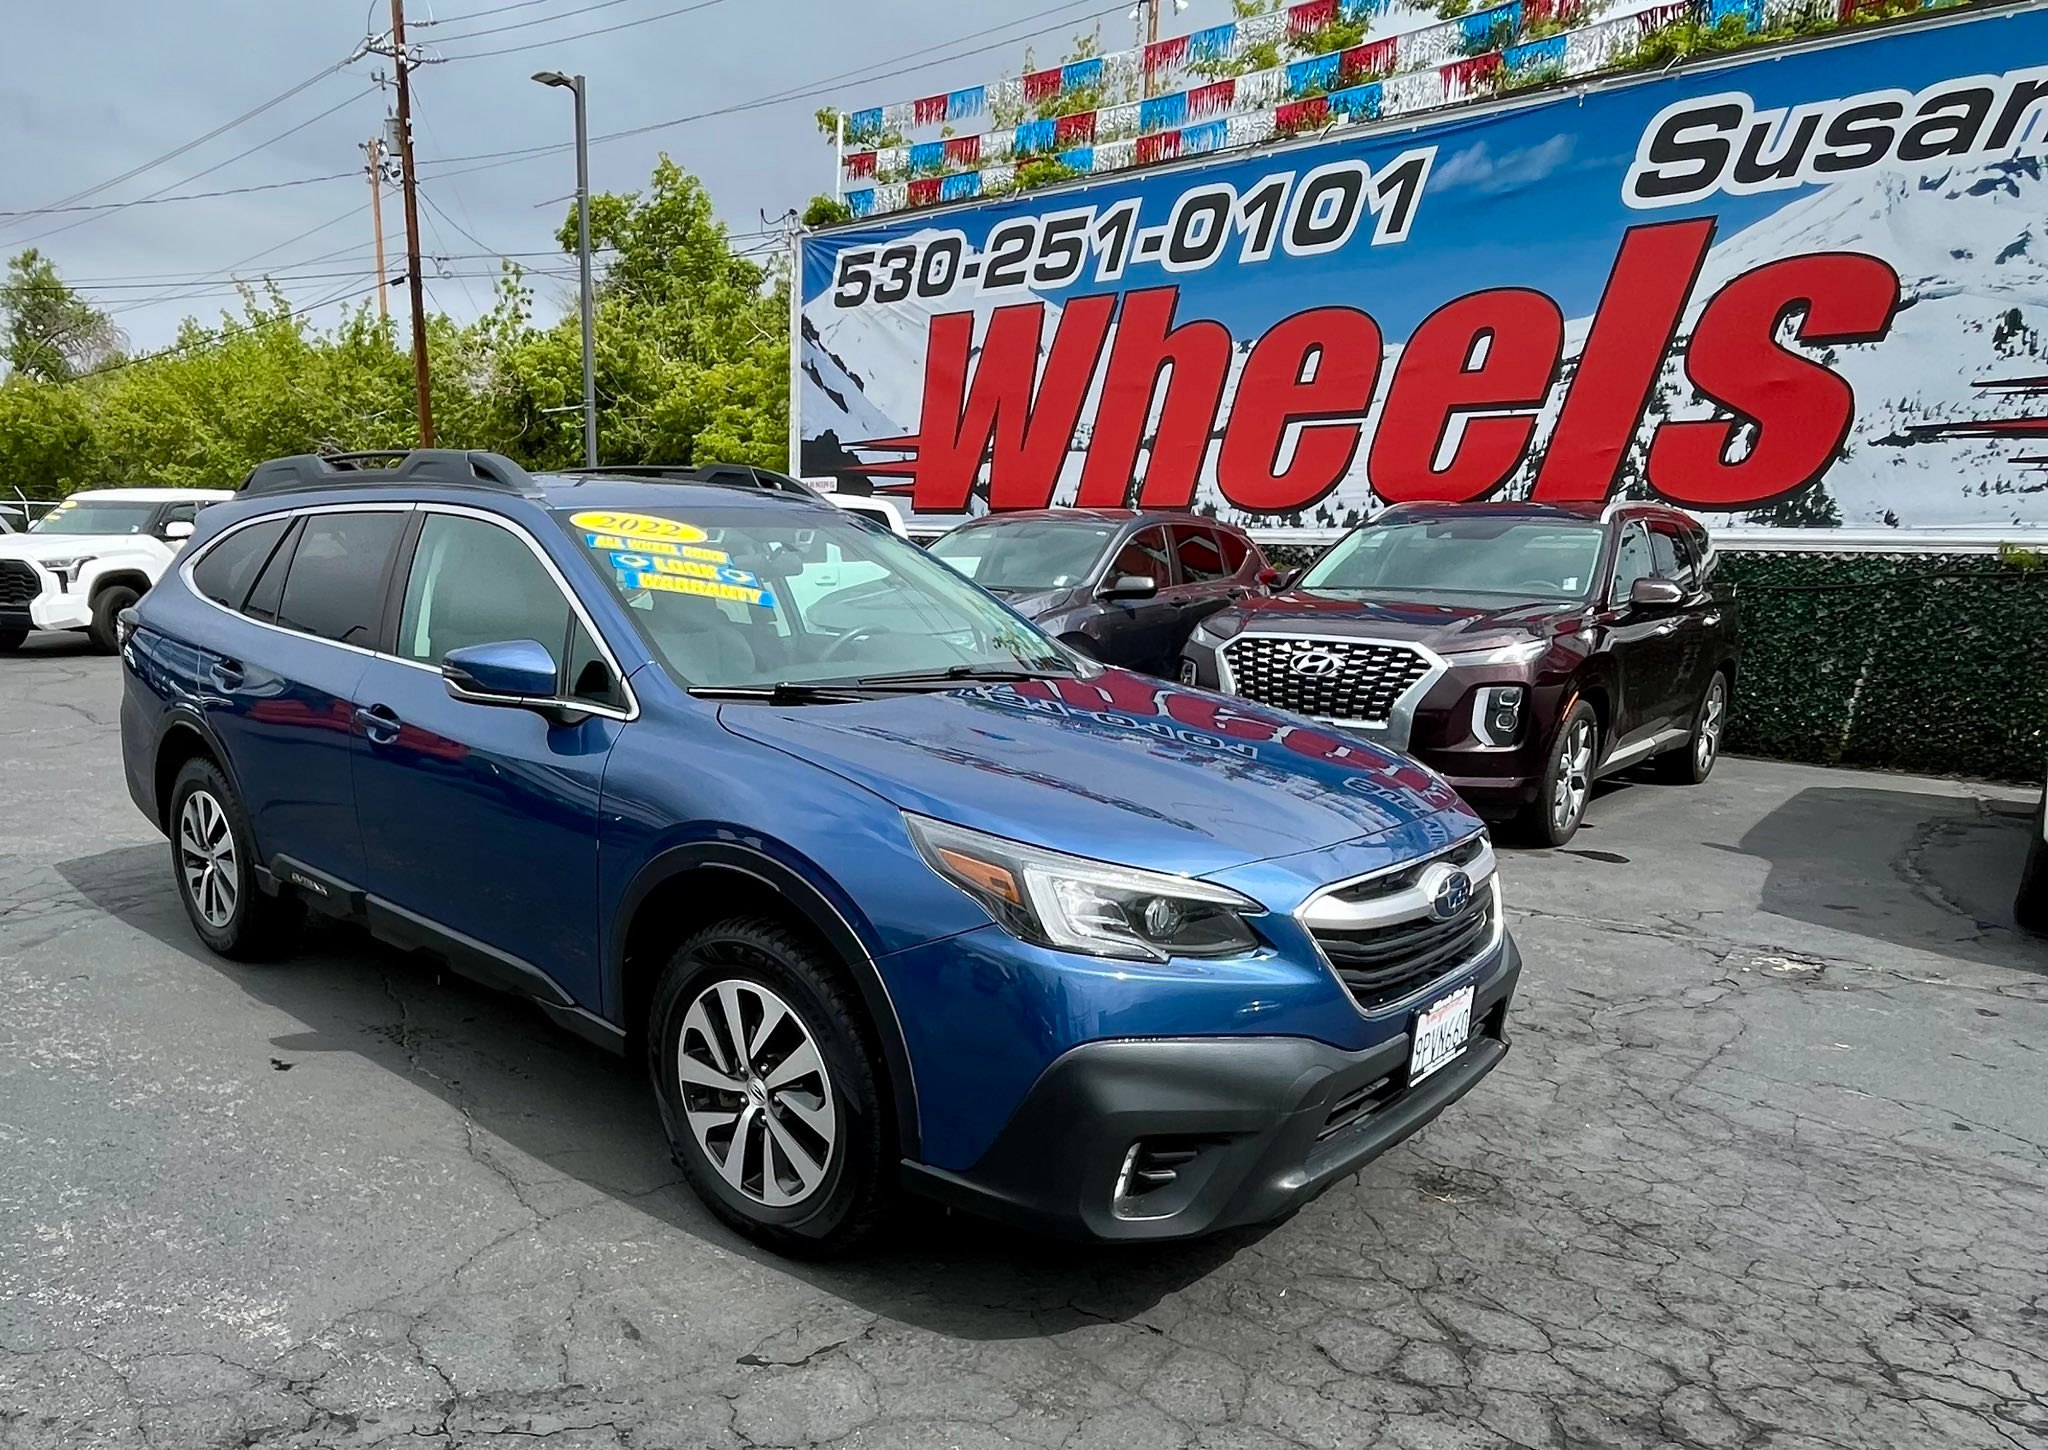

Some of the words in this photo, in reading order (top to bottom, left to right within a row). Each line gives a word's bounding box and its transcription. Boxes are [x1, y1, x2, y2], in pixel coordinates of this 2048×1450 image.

[833, 150, 1434, 309] 530-251-0101
[914, 216, 1901, 514] Wheels
[597, 516, 681, 537] 2022
[805, 481, 835, 489] RNING
